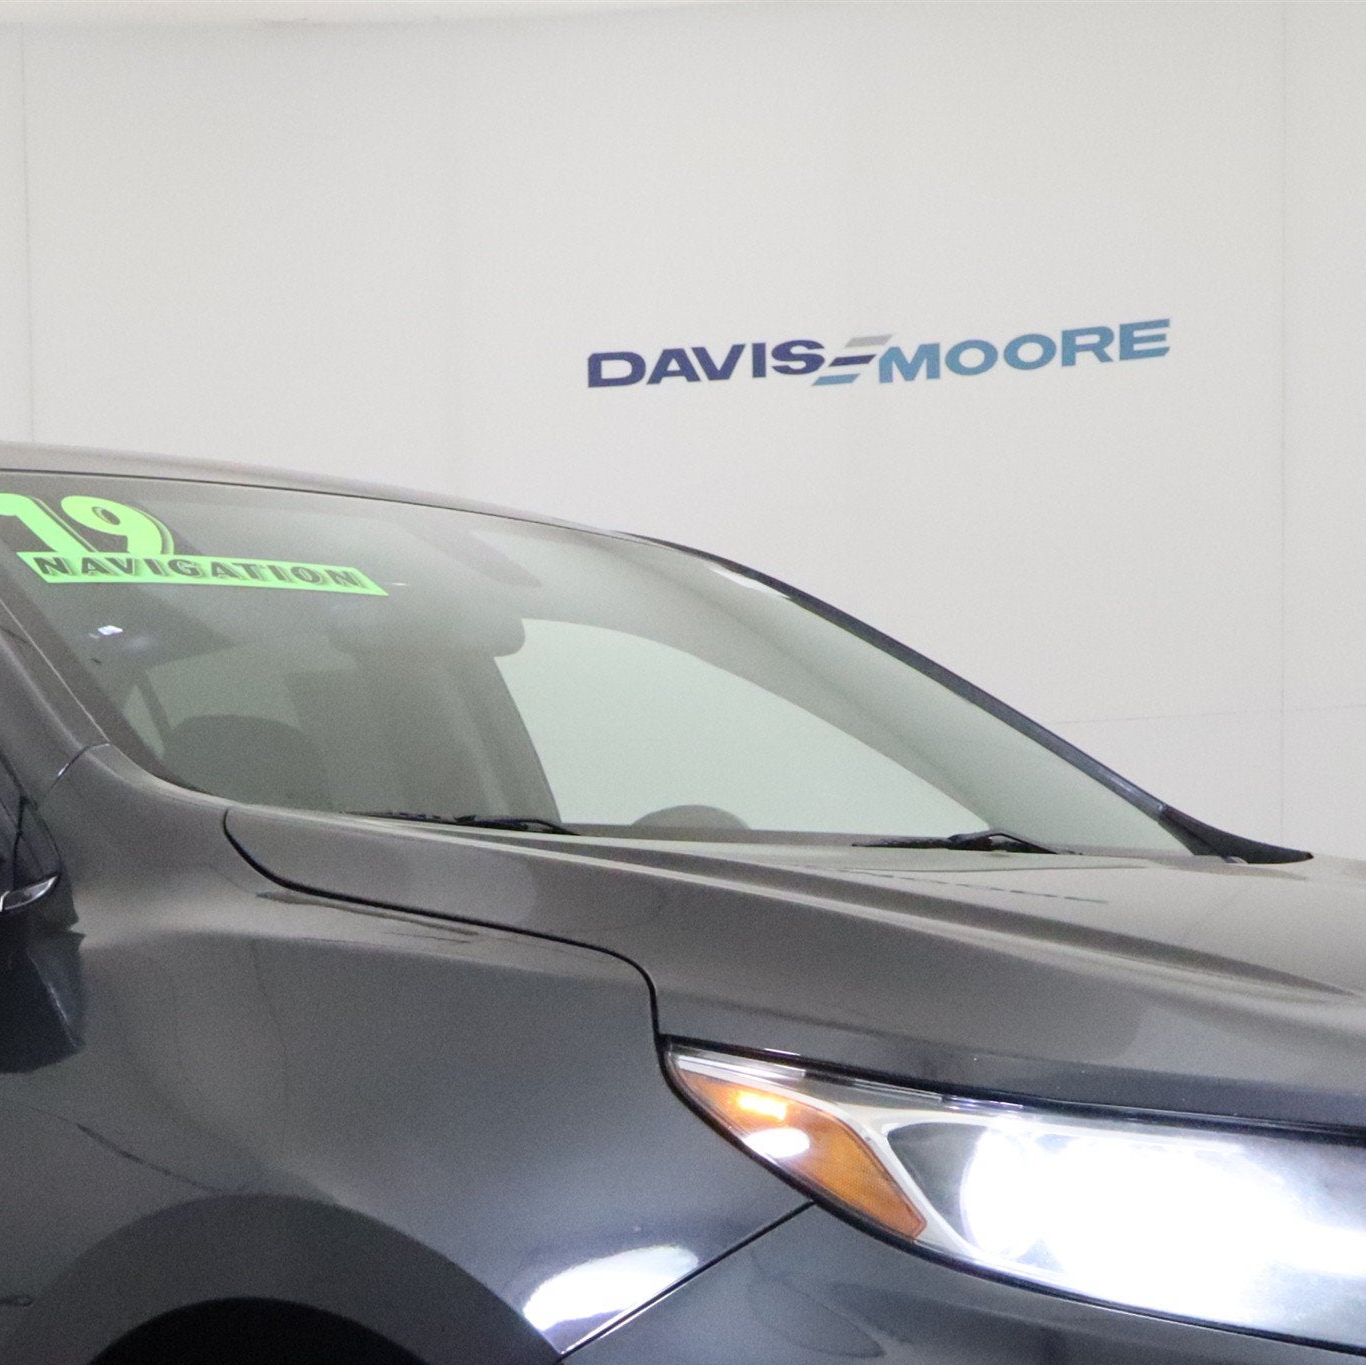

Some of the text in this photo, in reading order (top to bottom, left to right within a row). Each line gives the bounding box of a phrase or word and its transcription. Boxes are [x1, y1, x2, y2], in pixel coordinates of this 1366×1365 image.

[587, 318, 1170, 388] DAVIS MOORE
[32, 556, 371, 589] NAVIGATION
